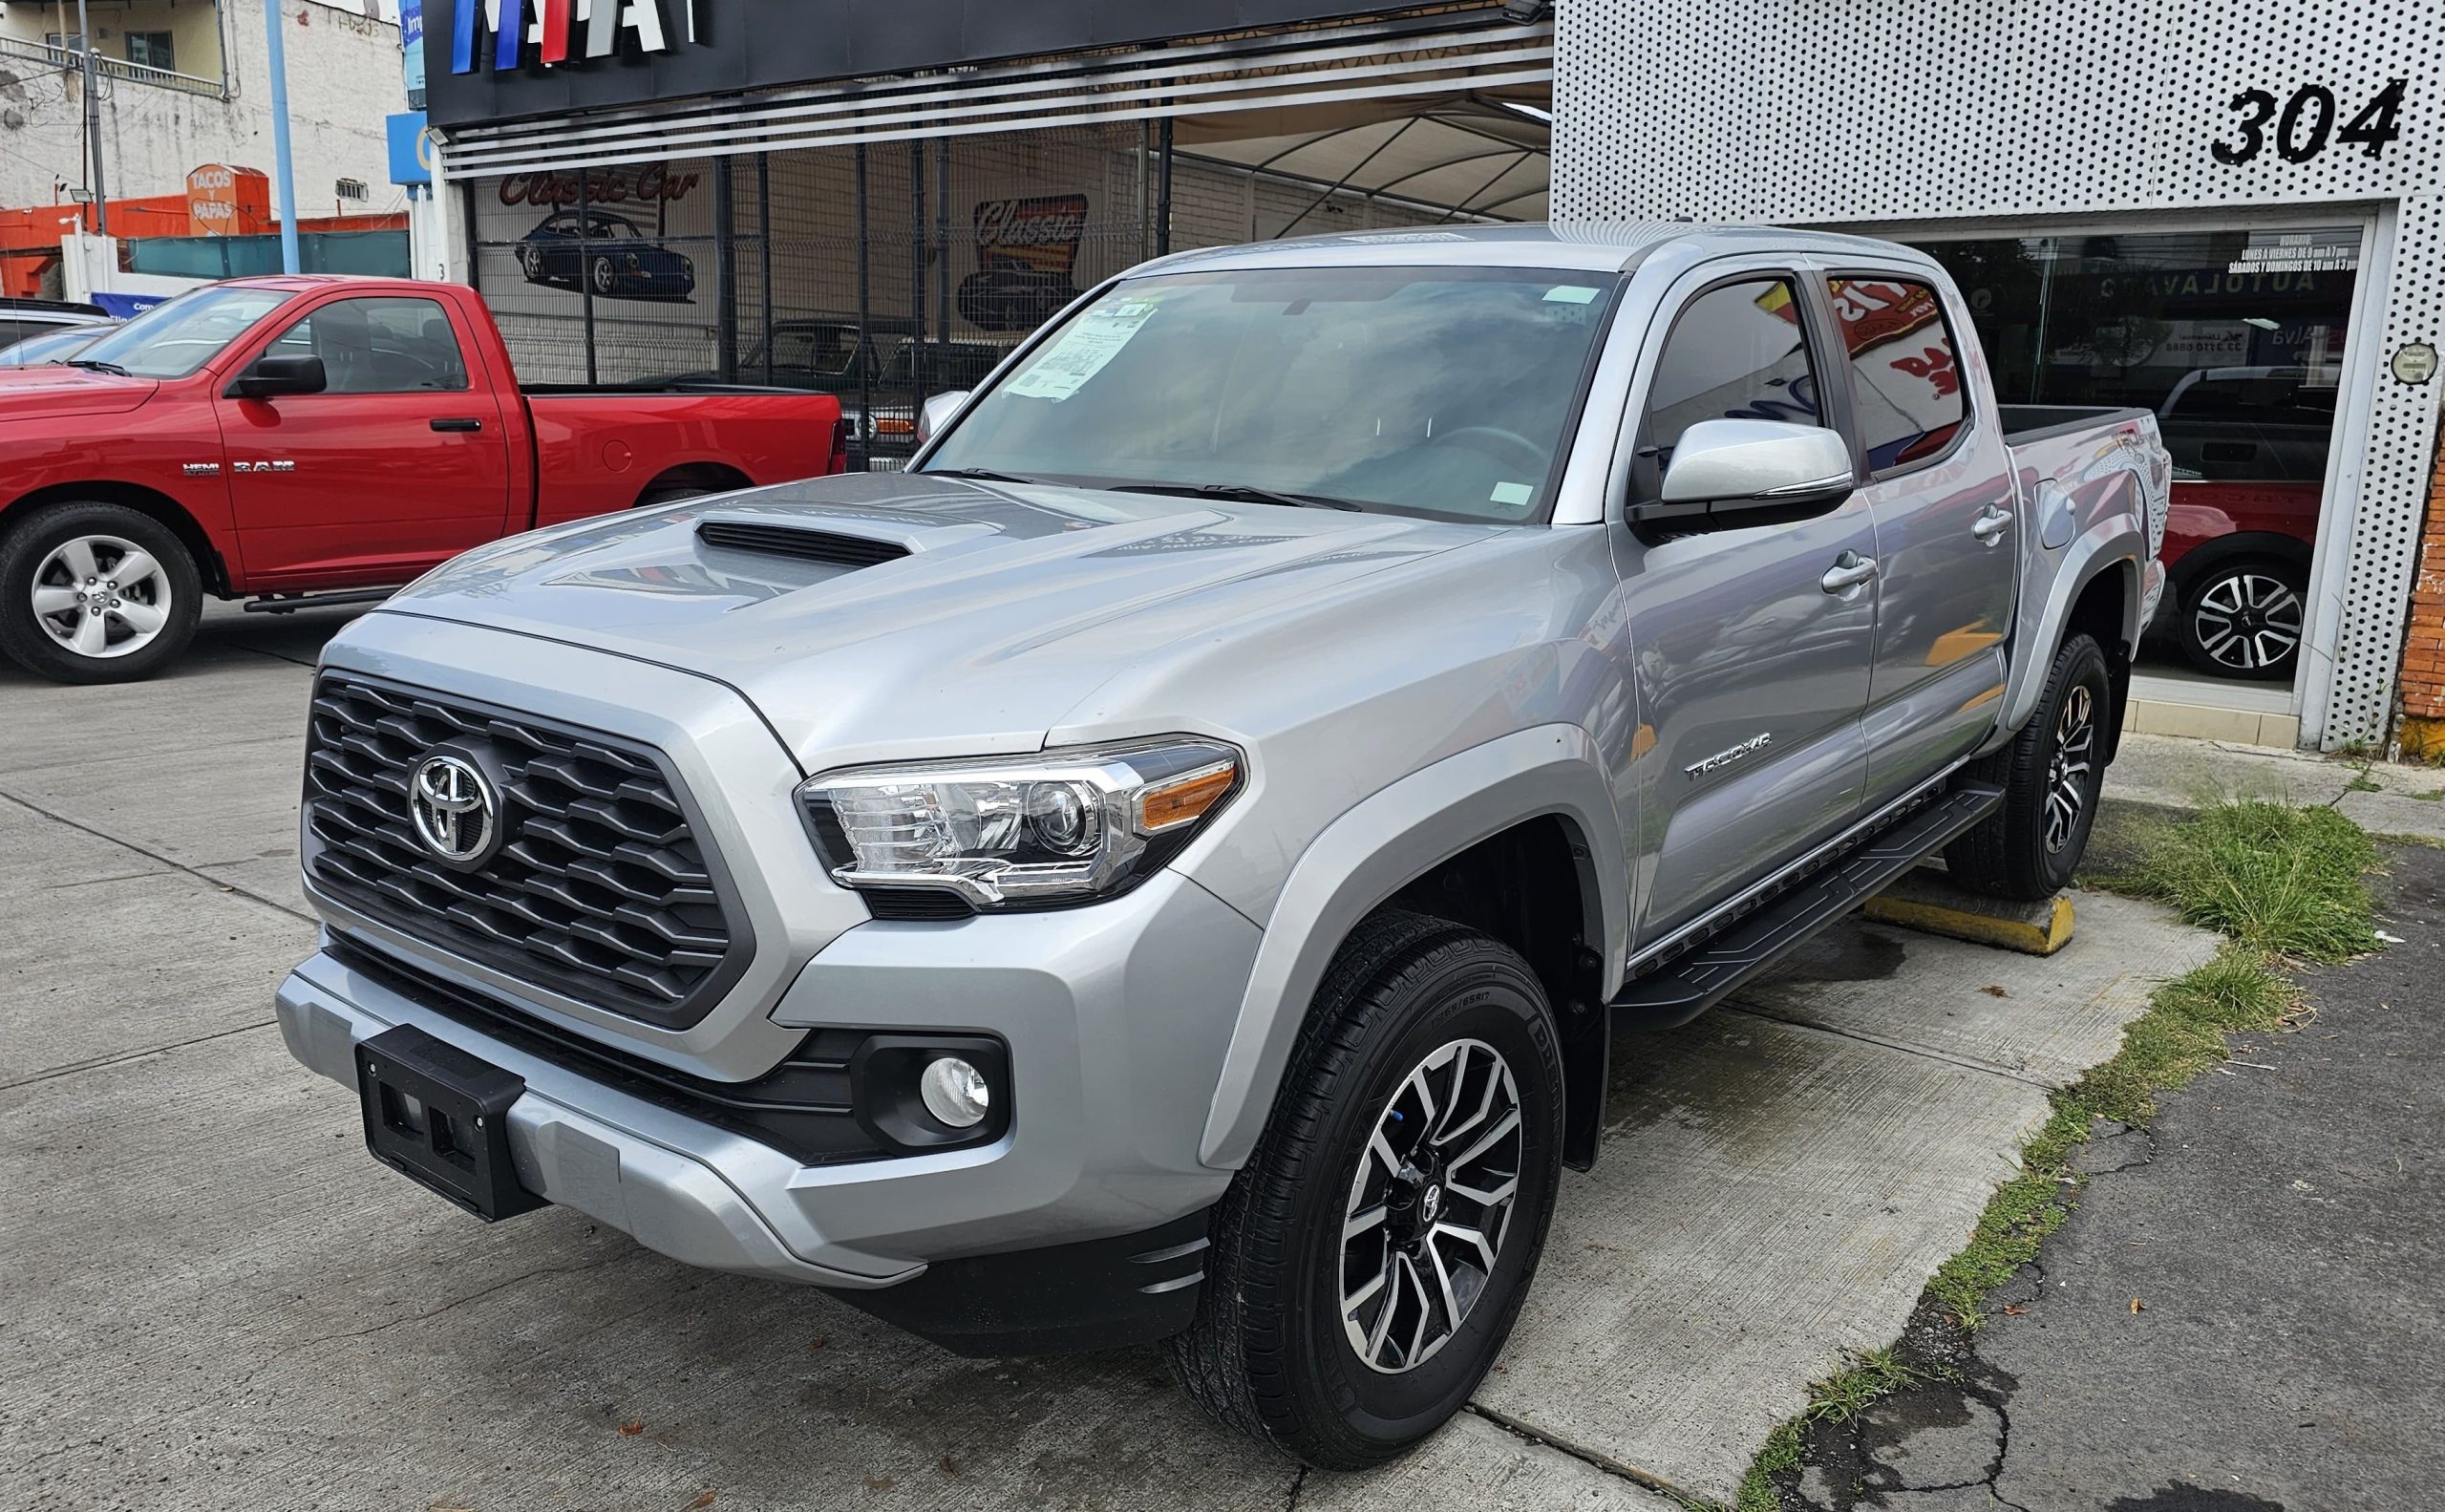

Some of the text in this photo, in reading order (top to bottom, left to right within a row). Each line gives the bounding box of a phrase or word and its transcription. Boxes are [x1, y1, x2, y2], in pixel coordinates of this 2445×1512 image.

[2211, 78, 2409, 165] 304
[192, 171, 232, 189] TACOS
[500, 160, 699, 206] Classic Car
[208, 189, 215, 202] Y
[193, 201, 235, 220] PAPAS
[2280, 235, 2312, 246] HORARIO:
[2242, 248, 2262, 261] LUNES
[2263, 248, 2268, 259] A
[2268, 247, 2296, 259] VIERNES
[2297, 247, 2307, 258] DE
[2307, 247, 2312, 258] 9
[2313, 248, 2325, 258] am
[2325, 245, 2330, 258] A
[2331, 245, 2336, 257] 7
[2228, 260, 2261, 273] SÁBADOS
[2261, 261, 2266, 272] Y
[2265, 260, 2302, 272] DOMINGOS
[2303, 260, 2312, 271] DE
[2313, 259, 2322, 271] 10
[2322, 261, 2334, 271] am
[2334, 259, 2340, 270] A
[2340, 259, 2346, 270] 3
[233, 460, 294, 473] RAM
[1684, 733, 1772, 781] TACOMA
